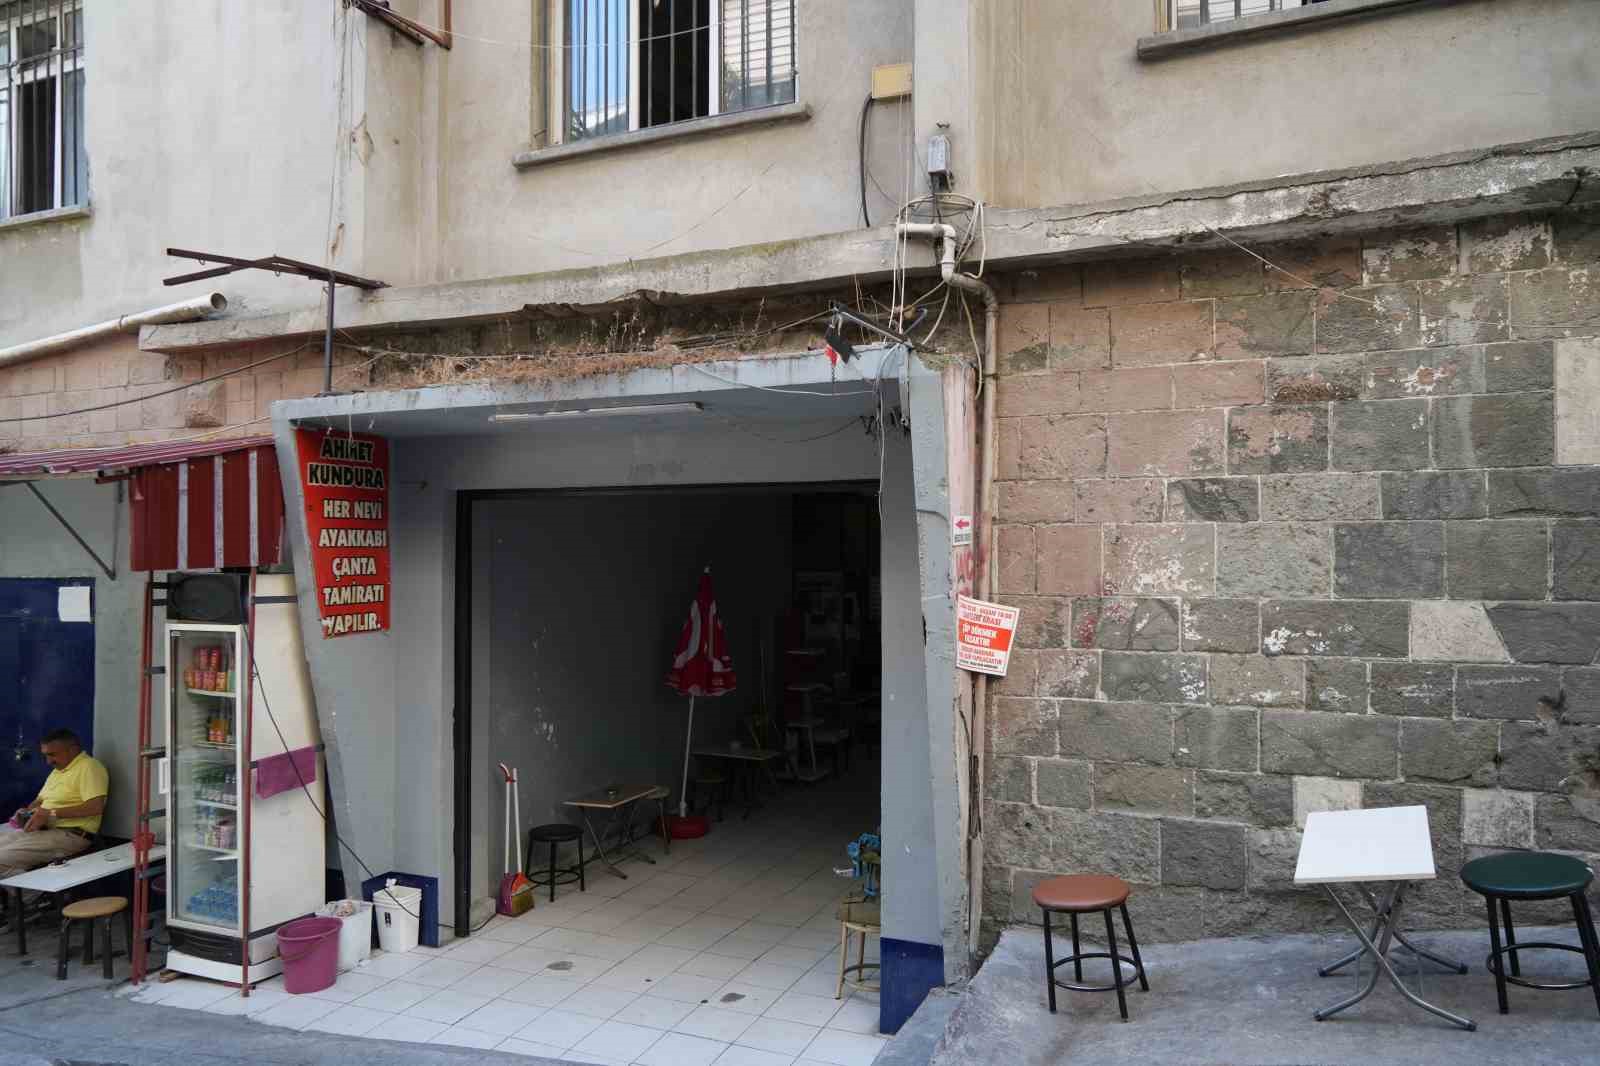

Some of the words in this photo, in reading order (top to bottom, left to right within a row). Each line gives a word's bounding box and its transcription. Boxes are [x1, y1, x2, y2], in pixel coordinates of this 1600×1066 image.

[307, 463, 384, 490] KUNDURA
[323, 498, 350, 518] HER
[319, 528, 387, 547] AYAKKABI
[332, 557, 376, 582] ÇANTA
[323, 581, 384, 605] TAMİRATI
